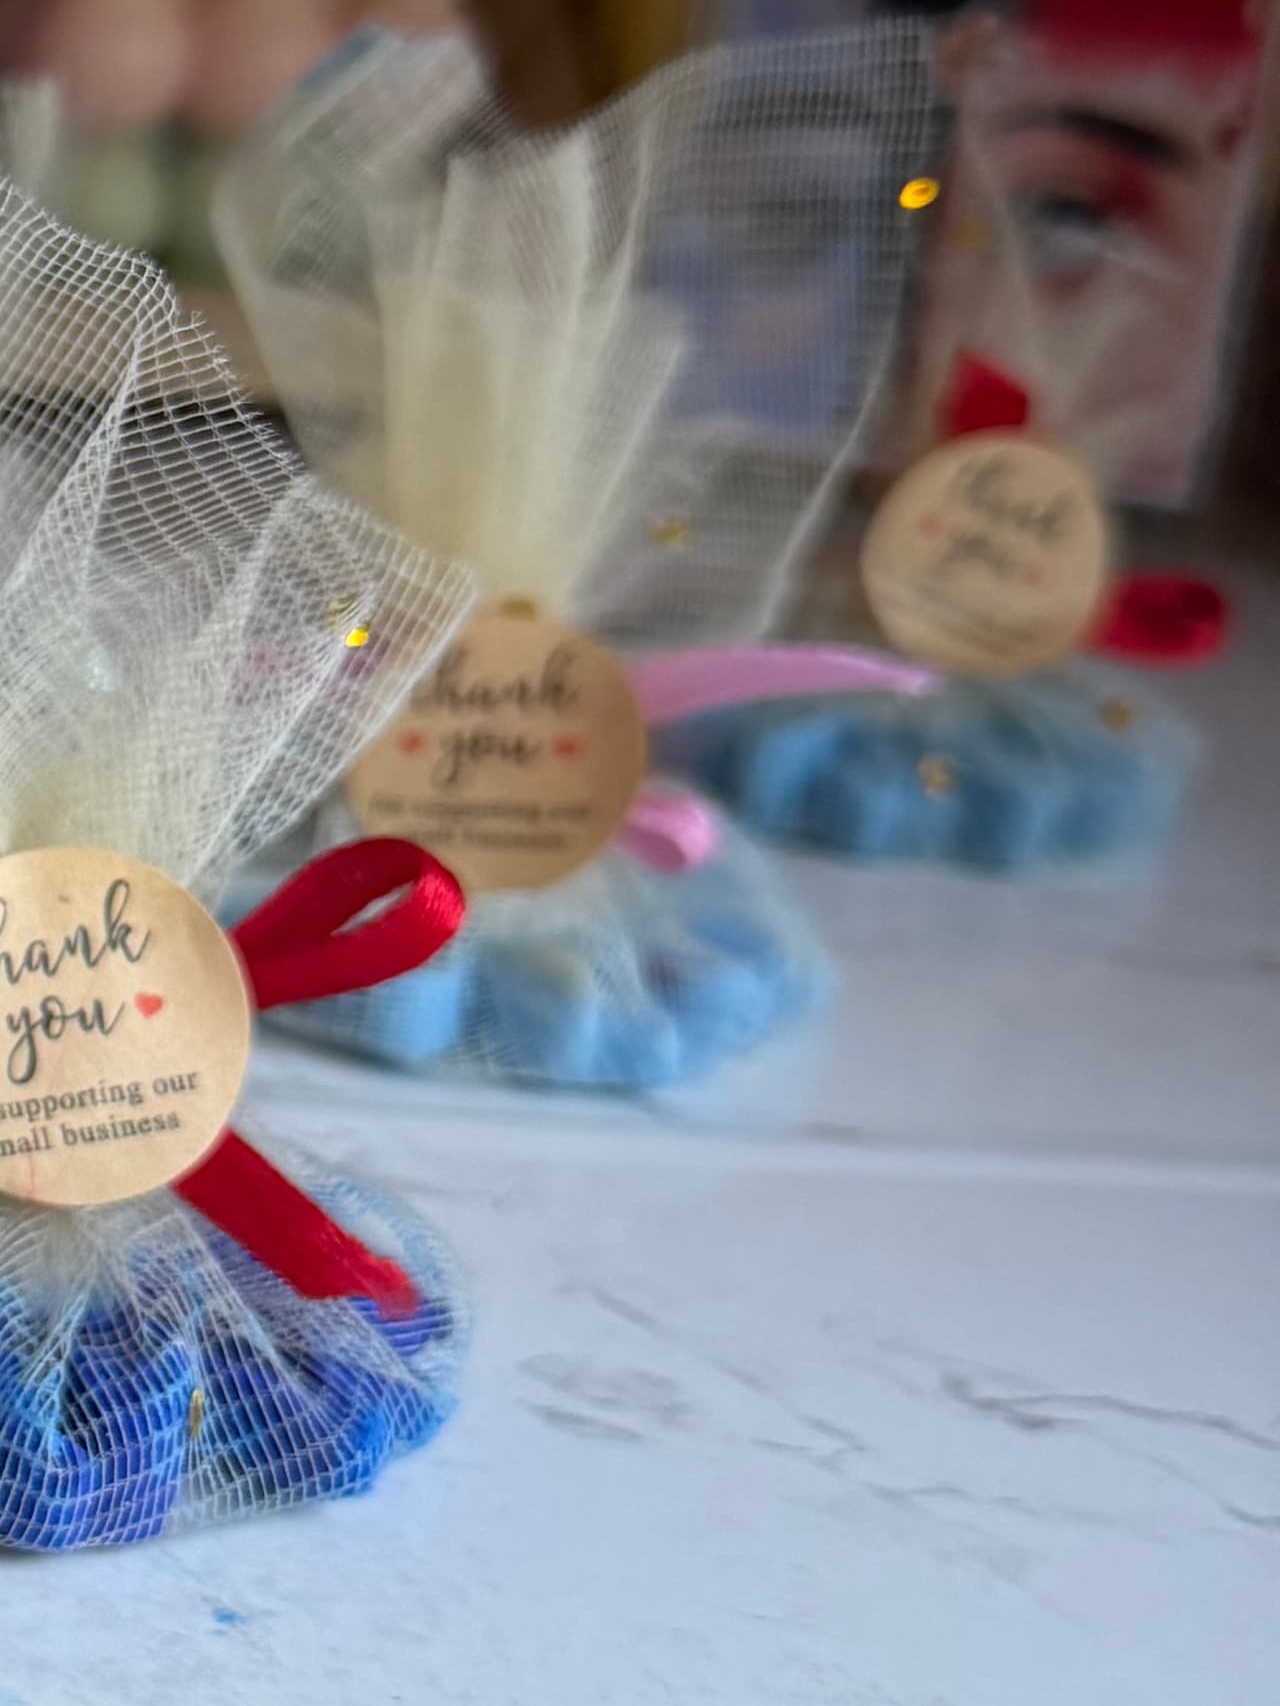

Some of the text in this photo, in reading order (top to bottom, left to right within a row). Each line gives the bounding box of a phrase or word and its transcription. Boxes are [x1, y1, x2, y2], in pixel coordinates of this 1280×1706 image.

[5, 994, 125, 1085] you
[152, 1071, 198, 1095] our
[61, 1109, 181, 1147] business
